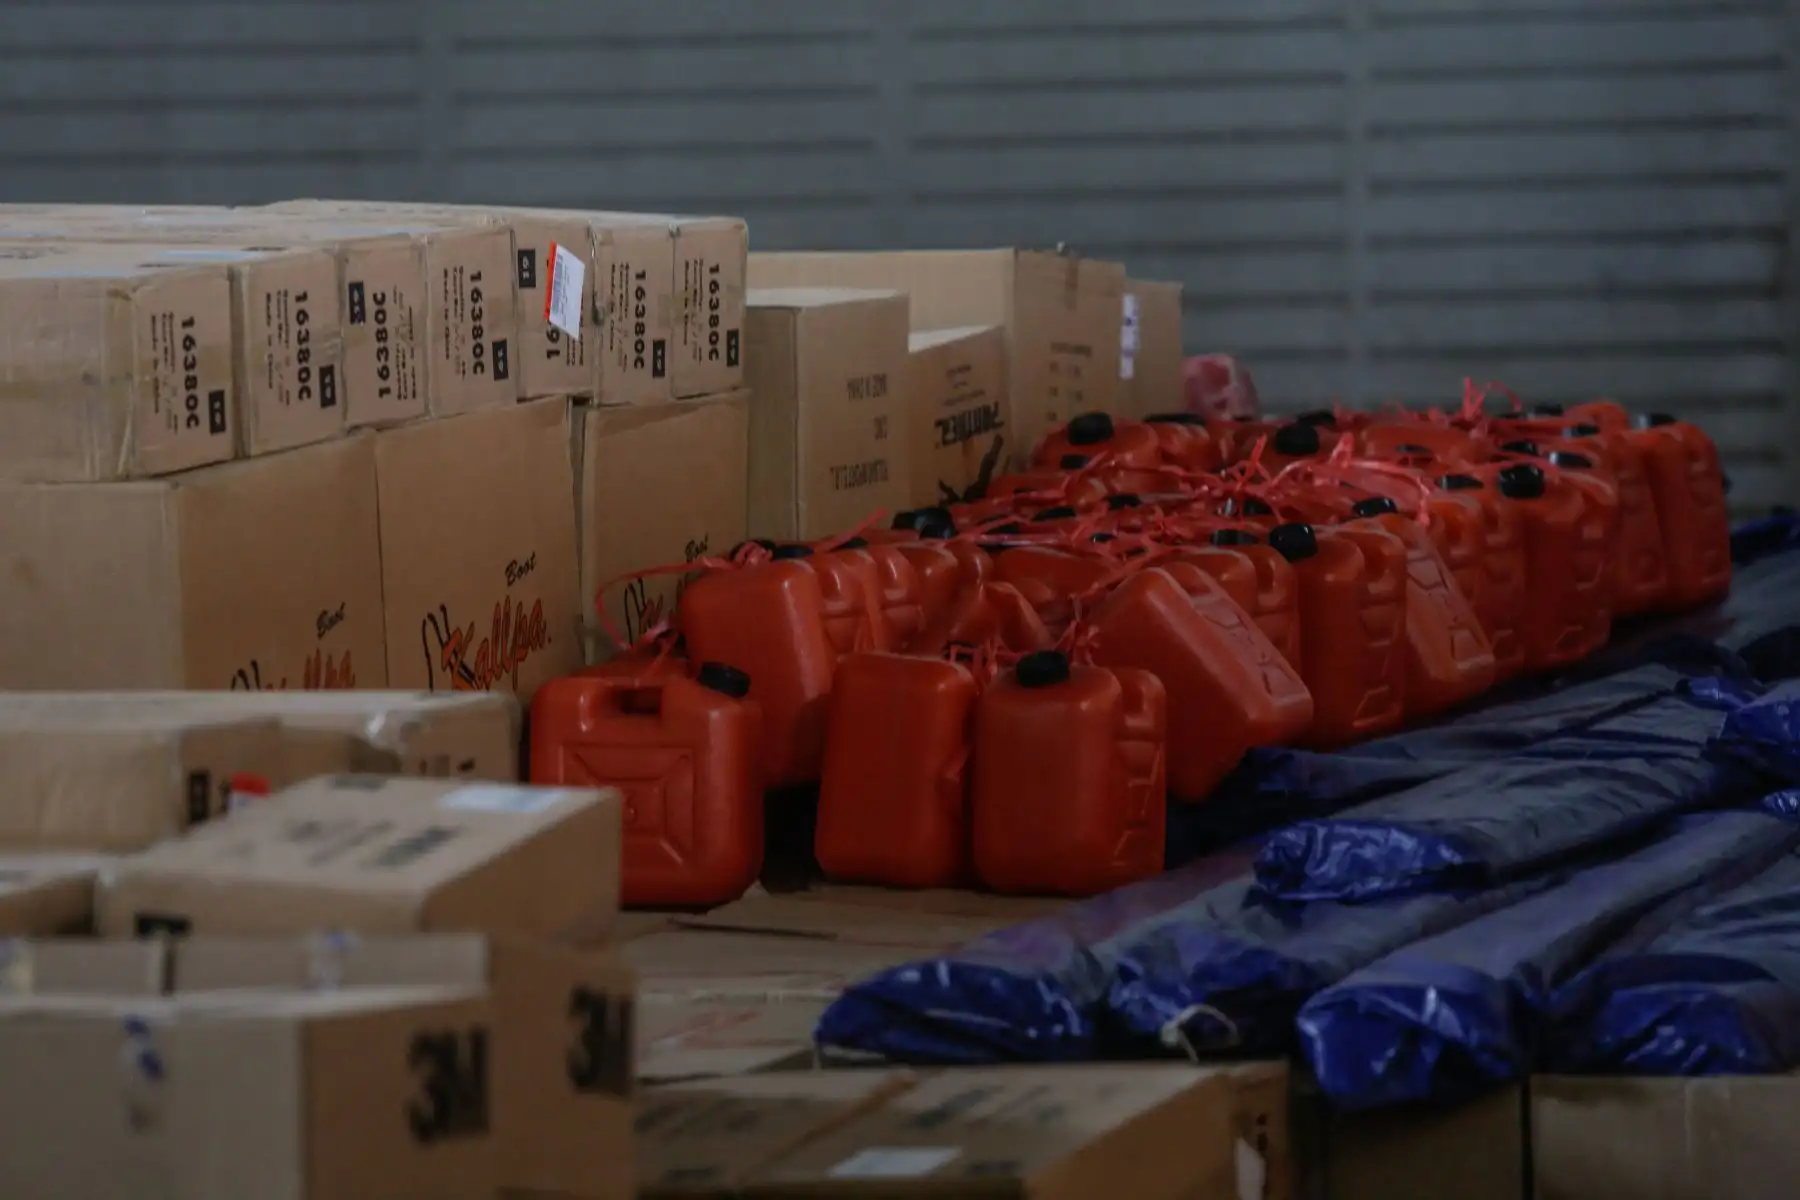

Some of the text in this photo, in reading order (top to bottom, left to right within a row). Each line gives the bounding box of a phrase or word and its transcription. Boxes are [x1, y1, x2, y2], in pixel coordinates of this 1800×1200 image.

[294, 290, 312, 401] 16380C
[371, 291, 392, 399] 16380C
[470, 269, 485, 376] 16380C
[634, 269, 646, 370] 16380C
[708, 263, 720, 362] 16380C
[181, 316, 200, 429] 16380C
[504, 551, 537, 588] Boot
[407, 1022, 490, 1143] 3M
